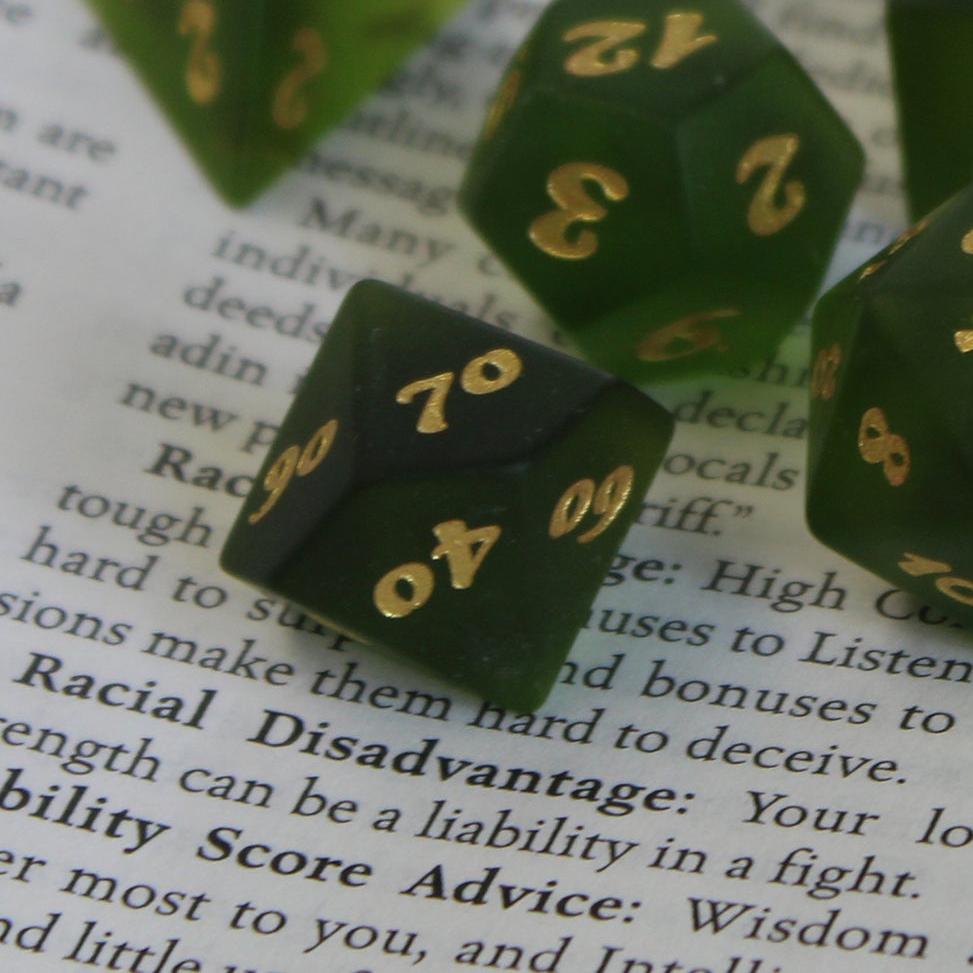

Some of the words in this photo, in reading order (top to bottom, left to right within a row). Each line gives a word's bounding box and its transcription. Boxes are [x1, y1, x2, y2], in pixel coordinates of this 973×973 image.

[562, 12, 718, 78] 12
[301, 195, 457, 269] Many
[528, 162, 629, 259] 3
[149, 330, 269, 388] adin
[396, 349, 523, 434] 70
[119, 381, 239, 433] new
[662, 451, 799, 492] ocals
[858, 407, 911, 487] 8
[56, 483, 216, 548] tough
[20, 525, 161, 592] hard
[171, 575, 229, 610] to
[700, 558, 848, 614] High
[732, 625, 786, 659] to
[141, 630, 296, 687] make
[309, 661, 454, 722] them
[466, 698, 606, 745] hard
[613, 722, 671, 755] to
[684, 724, 908, 786] deceive.
[640, 658, 879, 726] bonuses
[898, 704, 956, 735] to
[13, 651, 218, 731] Racial
[246, 708, 697, 818] Disadvantage:
[741, 788, 880, 838] Your
[179, 768, 276, 809] can
[290, 776, 359, 824] be
[372, 806, 402, 833] a
[413, 799, 641, 874] liability
[647, 836, 708, 875] in
[725, 855, 756, 881] a
[767, 846, 922, 901] fight.
[59, 868, 213, 922] most
[229, 901, 288, 935] to
[303, 917, 427, 966] you,
[454, 935, 574, 973] and
[196, 826, 375, 889] Score
[400, 863, 642, 924] Advice:
[687, 896, 930, 960] Wisdom
[62, 920, 202, 973] little
